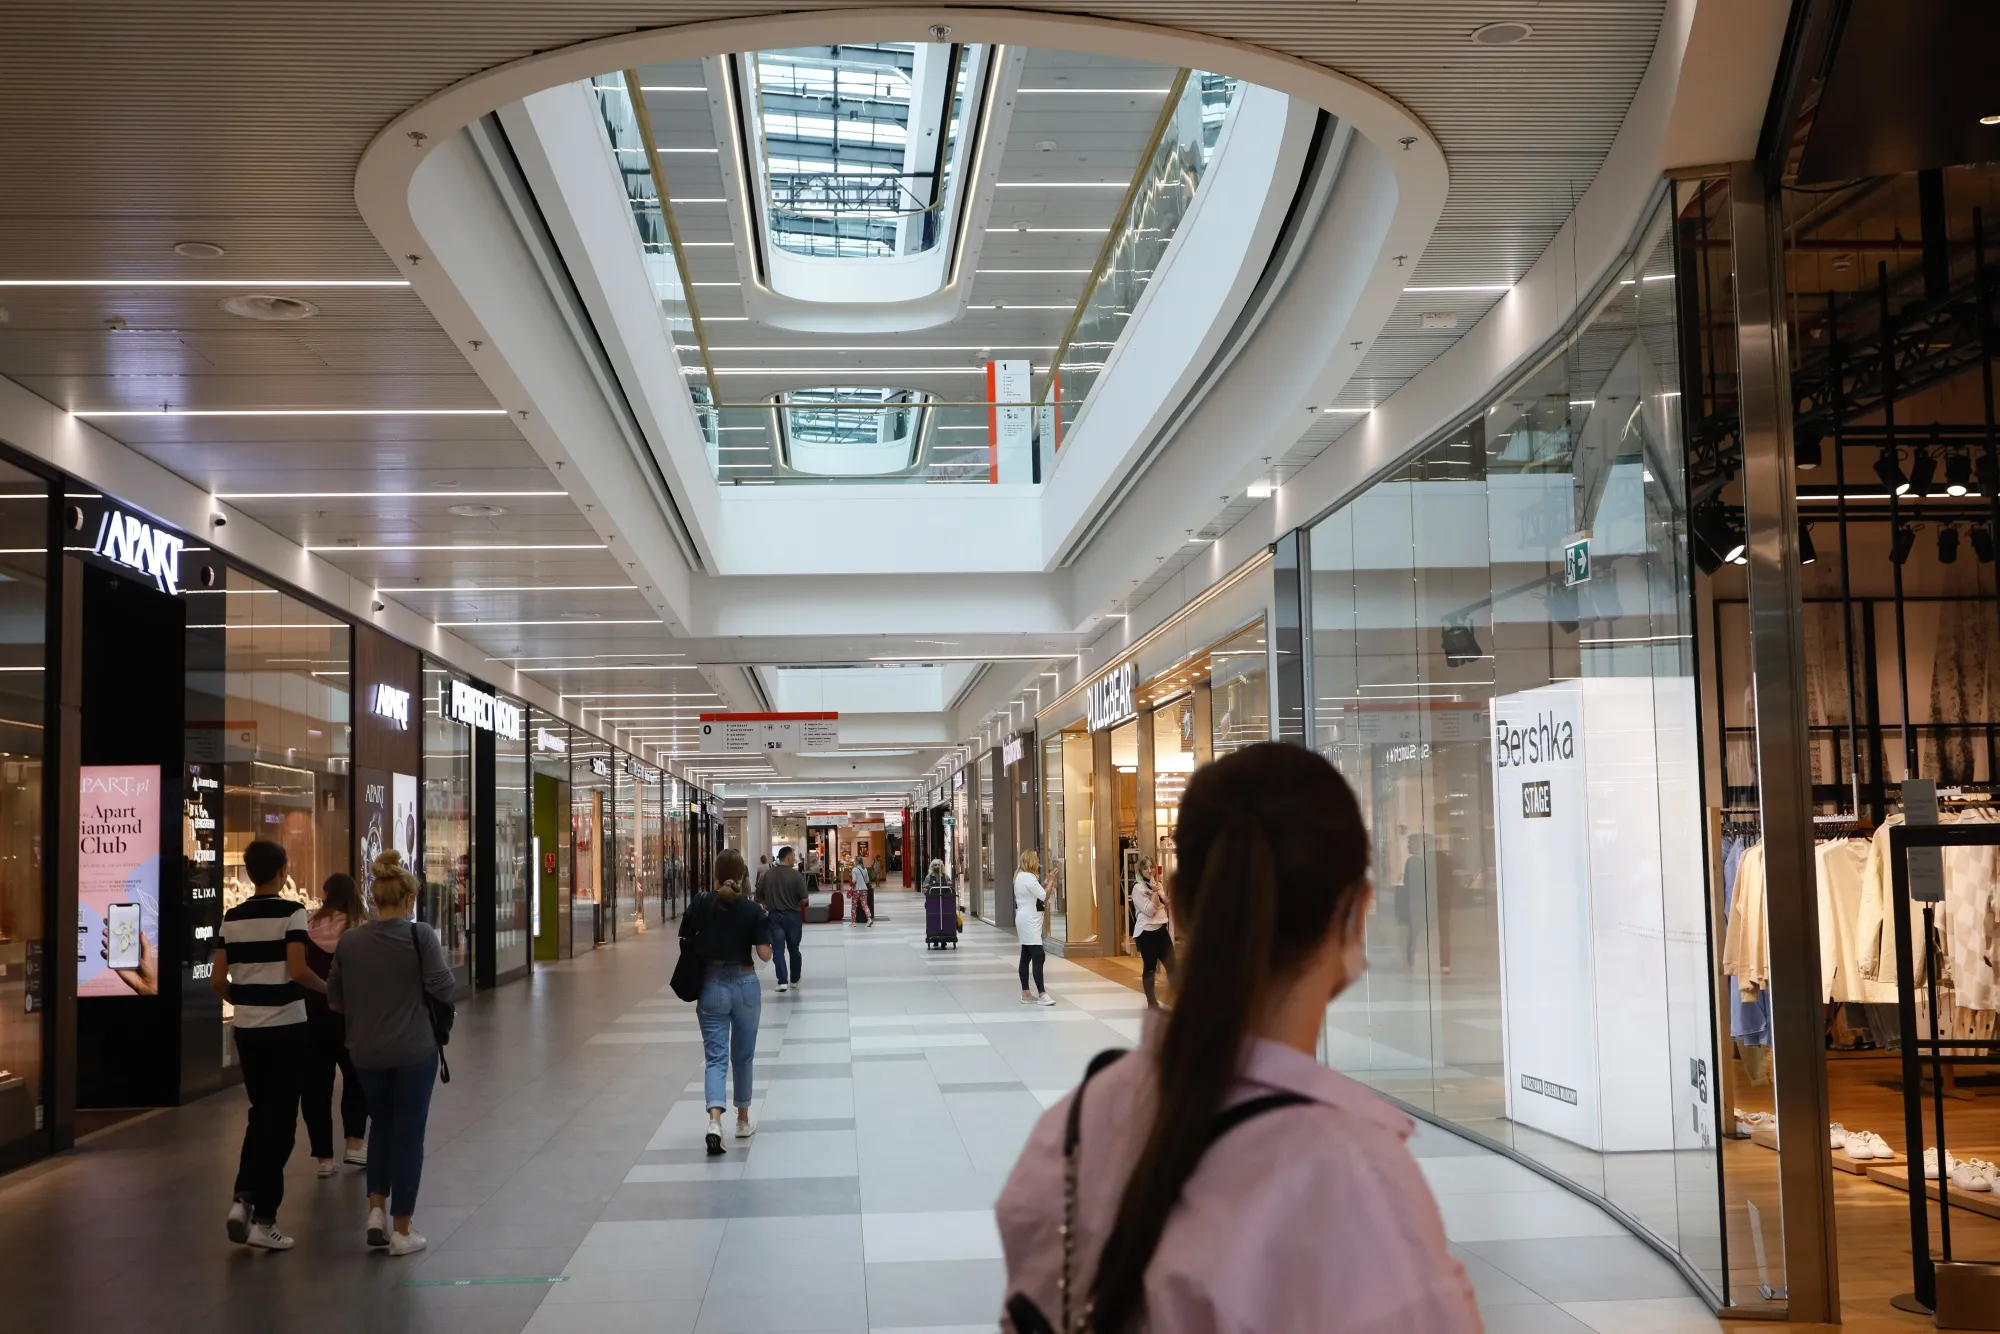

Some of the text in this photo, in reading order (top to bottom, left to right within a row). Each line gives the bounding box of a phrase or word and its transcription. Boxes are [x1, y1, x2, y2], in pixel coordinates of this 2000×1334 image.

[1002, 363, 1007, 371] 1
[102, 510, 183, 595] APART
[375, 683, 410, 731] APART
[1087, 662, 1132, 733] PULL&BEAR
[452, 679, 494, 731] PERFECT
[494, 698, 519, 741] VISION
[703, 724, 712, 735] 0
[1496, 710, 1574, 768] Bershka
[80, 776, 150, 797] PART.pl
[365, 784, 385, 809] APART
[1524, 785, 1550, 814] STAGE
[91, 805, 137, 823] Apart
[81, 819, 142, 835] iamond
[80, 836, 127, 854] Club
[192, 887, 216, 899] ELIXA
